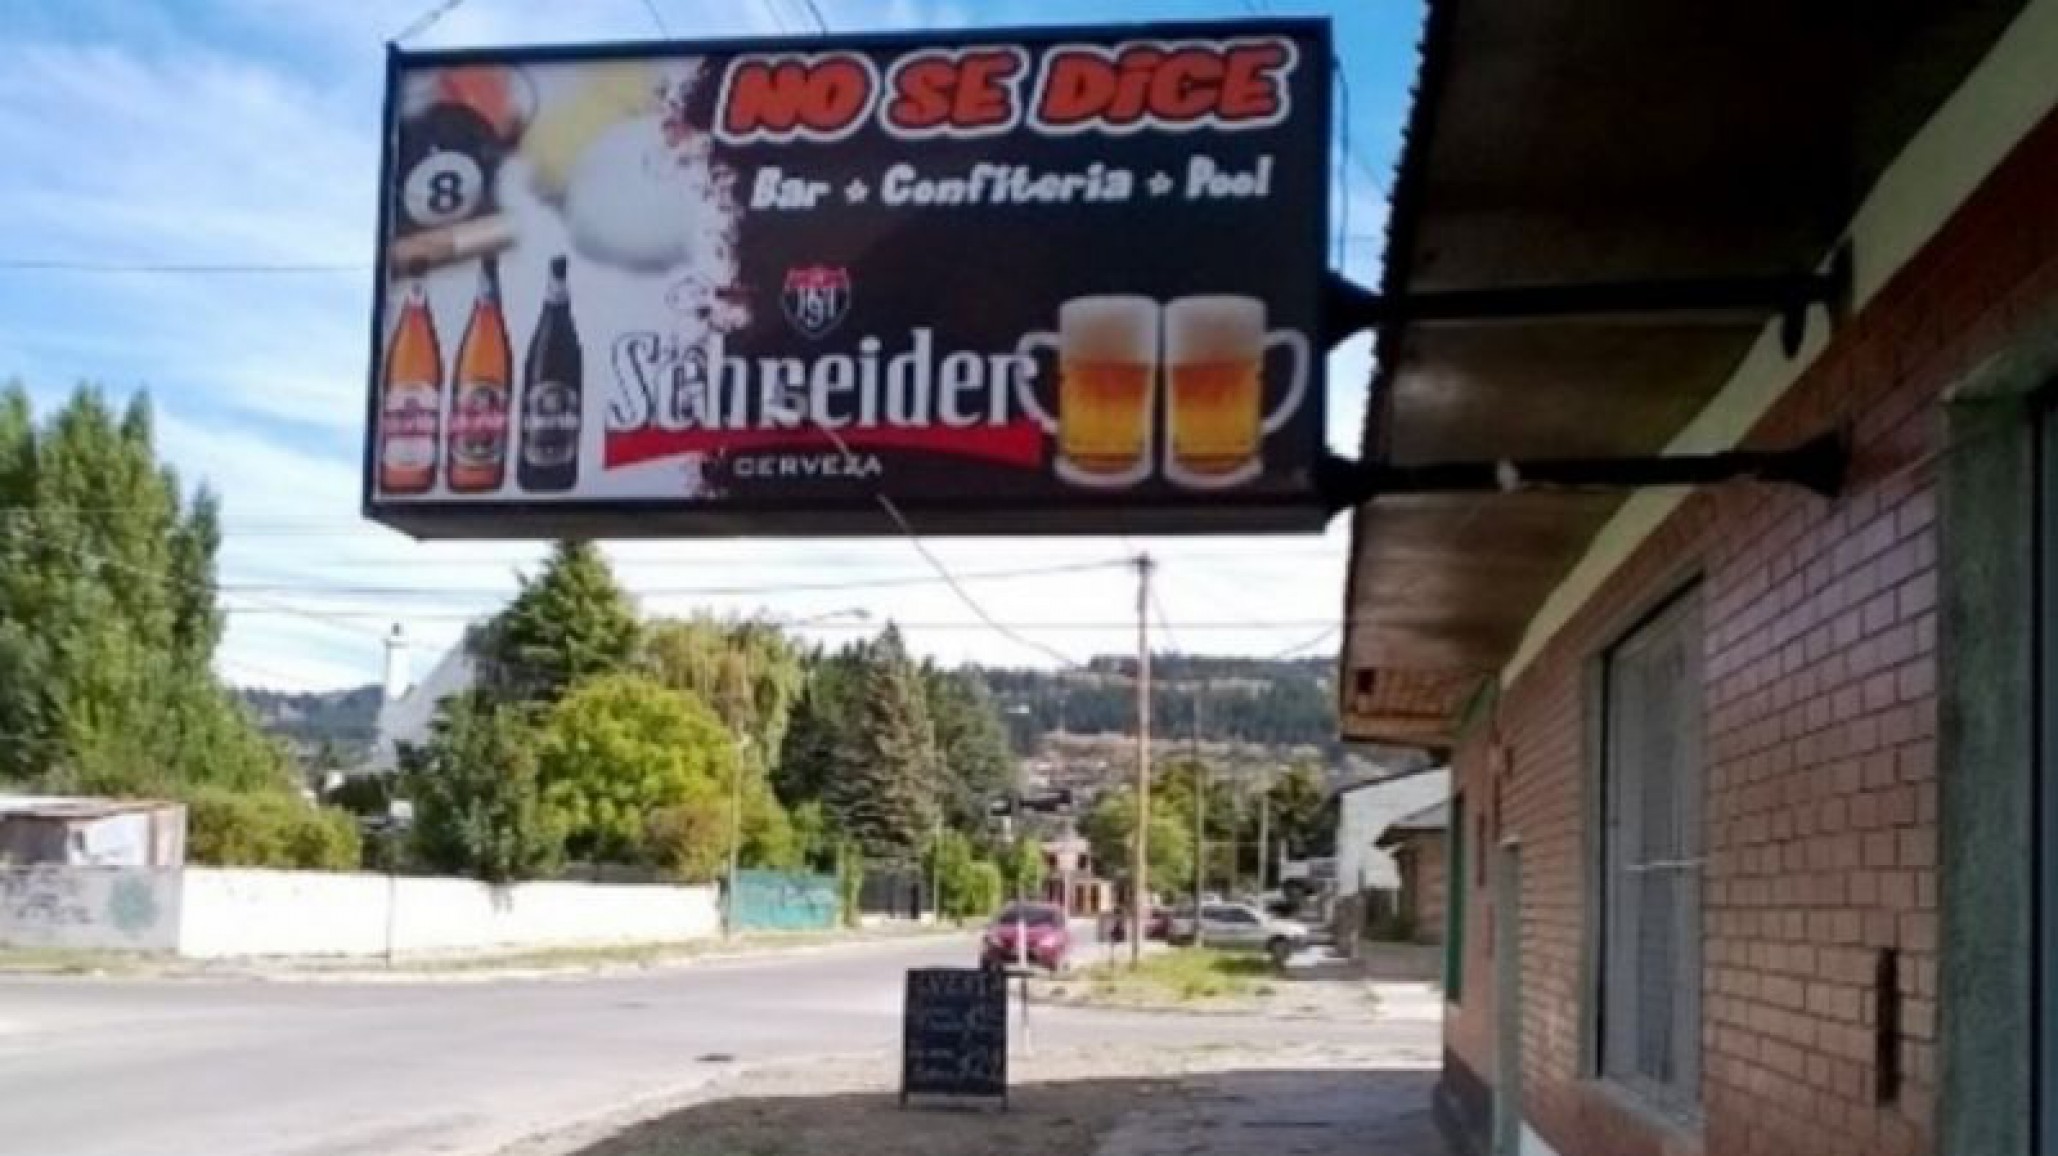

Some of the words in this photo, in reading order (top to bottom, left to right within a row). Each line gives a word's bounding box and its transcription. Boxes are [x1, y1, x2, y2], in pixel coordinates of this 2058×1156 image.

[719, 57, 876, 141] NO
[884, 48, 1026, 134] SE
[426, 172, 465, 213] 8
[751, 166, 831, 209] Bar
[881, 161, 1133, 206] Confiteria
[1185, 155, 1273, 198] Pool
[733, 452, 882, 477] CERVEZA
